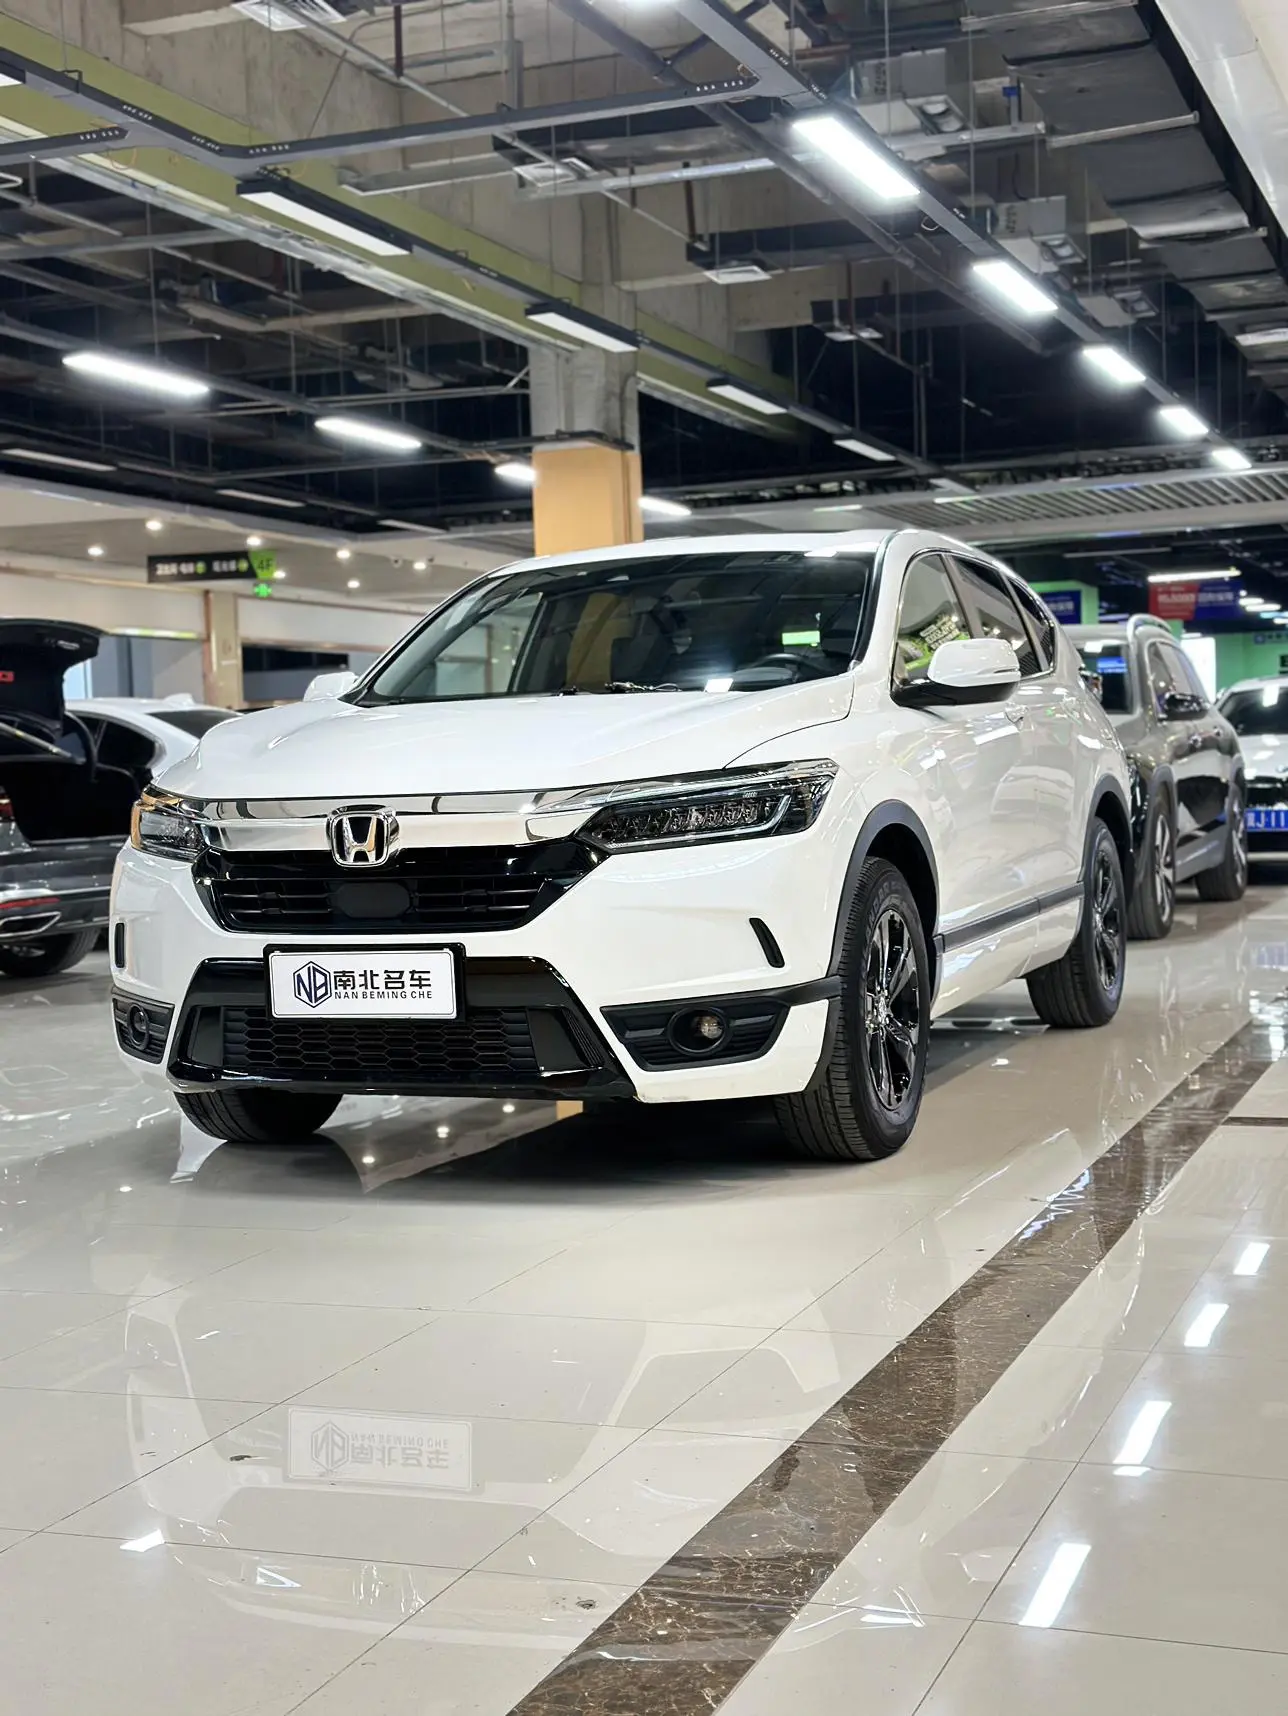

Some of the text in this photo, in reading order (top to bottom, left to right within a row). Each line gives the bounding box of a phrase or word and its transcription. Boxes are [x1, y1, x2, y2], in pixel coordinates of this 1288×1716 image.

[333, 969, 432, 991] 南北名车
[334, 990, 433, 1000] NAN BEMING CHE
